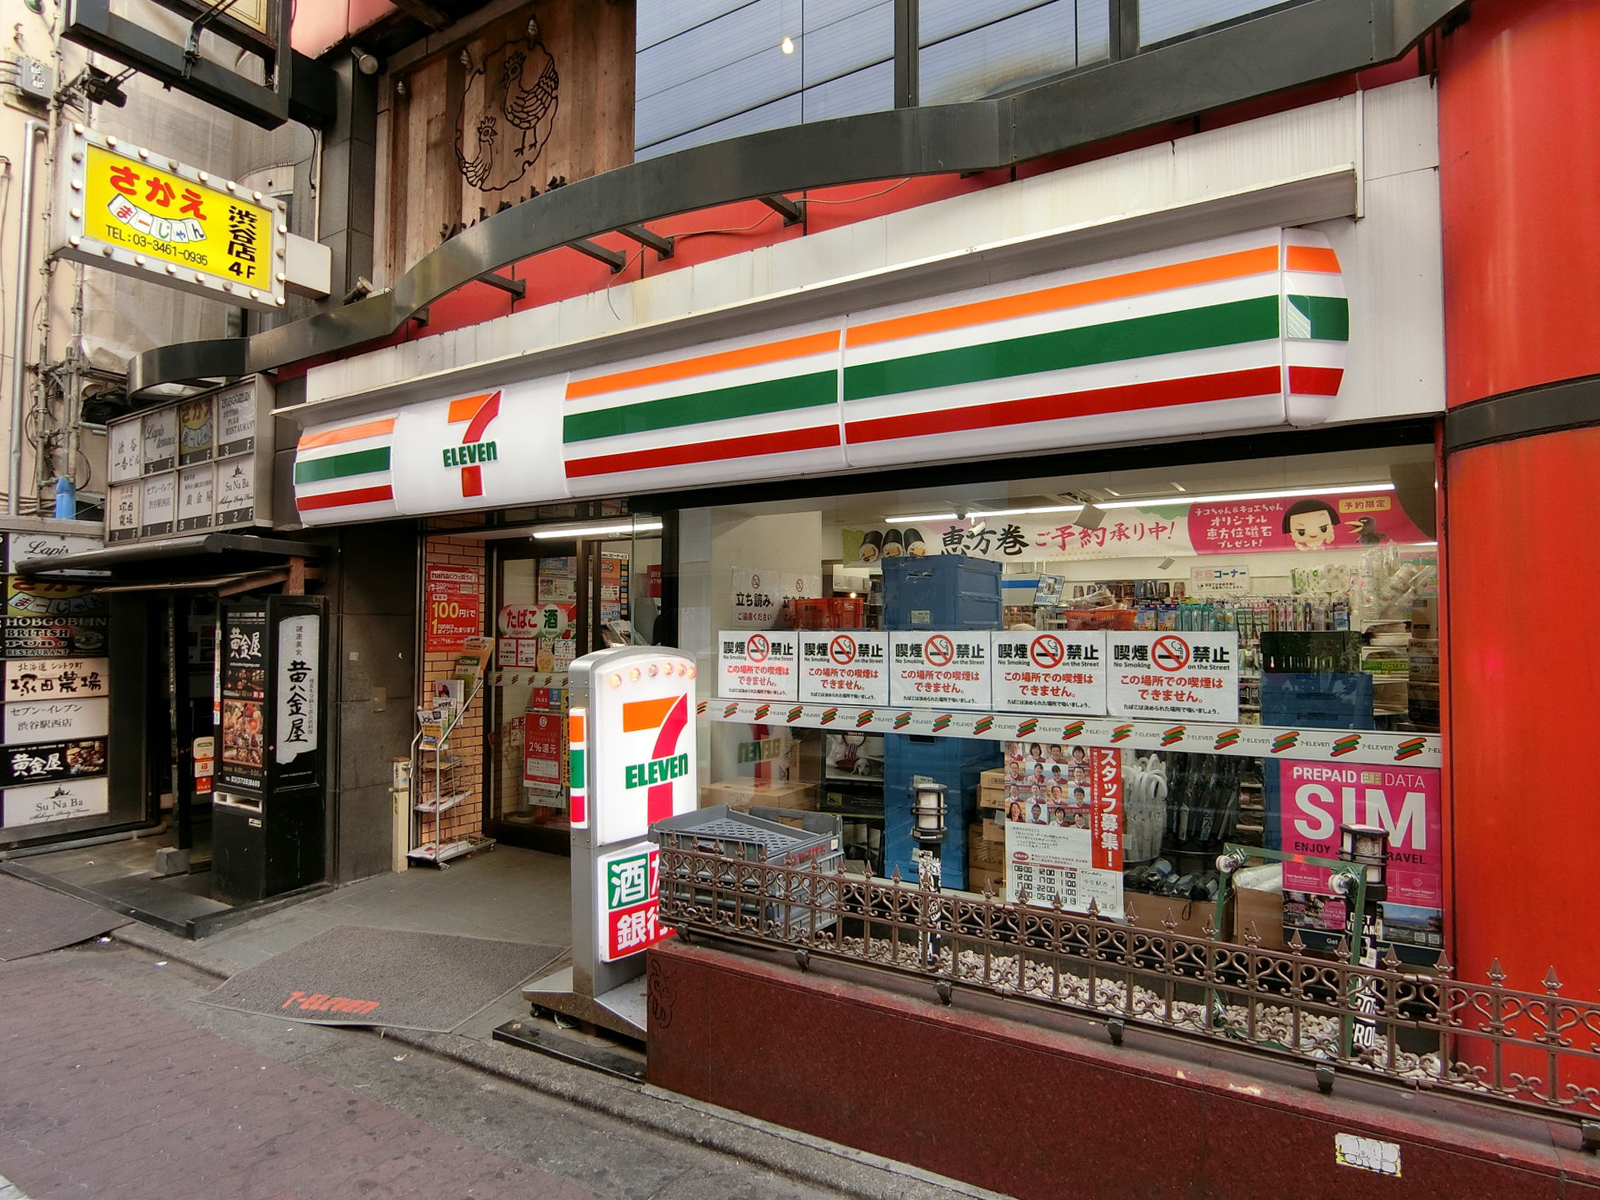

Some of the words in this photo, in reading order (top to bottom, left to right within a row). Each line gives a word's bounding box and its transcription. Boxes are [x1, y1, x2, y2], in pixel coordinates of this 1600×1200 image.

[109, 165, 208, 221] さかえ
[116, 202, 206, 242] まーじゃん
[227, 204, 258, 263] 渋谷店
[447, 389, 502, 498] 7
[1344, 499, 1387, 511] 予約限定
[1210, 514, 1268, 527] オリジナル
[940, 523, 1030, 556] 恵方巻
[1206, 526, 1273, 540] 恵方位磁石
[24, 540, 69, 556] Lapis
[506, 609, 538, 629] たばこ
[543, 608, 558, 629] 酒
[5, 628, 70, 638] BRITISH
[229, 626, 262, 660] 黄金屋
[723, 641, 746, 655] 喫煙
[771, 642, 794, 656] 禁止
[804, 642, 829, 657] 喫煙
[857, 643, 884, 658] 禁止
[6, 648, 70, 656] RESTAURANT
[895, 643, 923, 659] 喫煙
[955, 643, 985, 660] 禁止
[997, 643, 1028, 659] 喫煙
[1066, 644, 1099, 661] 禁止
[1113, 644, 1149, 661] 喫煙
[1193, 645, 1231, 664] 禁止
[808, 667, 879, 679] この場所での喫煙は
[1123, 662, 1151, 670] Smoking
[900, 669, 980, 681] この場所での喫煙は
[1004, 671, 1094, 684] この場所での喫煙は
[1120, 675, 1224, 689] この場所での喫煙は
[820, 679, 865, 691] できません。
[914, 681, 965, 695] できません。
[1019, 685, 1076, 698] できません。
[284, 660, 312, 743] 黄金屋
[1137, 688, 1203, 704] できません。
[18, 717, 72, 731] 渋谷駅西店
[528, 741, 558, 755] 2%還元
[11, 752, 64, 777] 黄金屋
[1293, 766, 1357, 783] PREPAID
[1384, 773, 1426, 789] DATA
[36, 802, 49, 812] Su
[52, 800, 67, 810] Na
[70, 798, 83, 808] Ba
[1293, 783, 1427, 850] SIM
[1294, 841, 1331, 854] ENJOY
[1386, 853, 1426, 865] RAVEL
[611, 858, 647, 907] 酒
[1349, 912, 1372, 925] DET
[1326, 937, 1339, 946] Get
